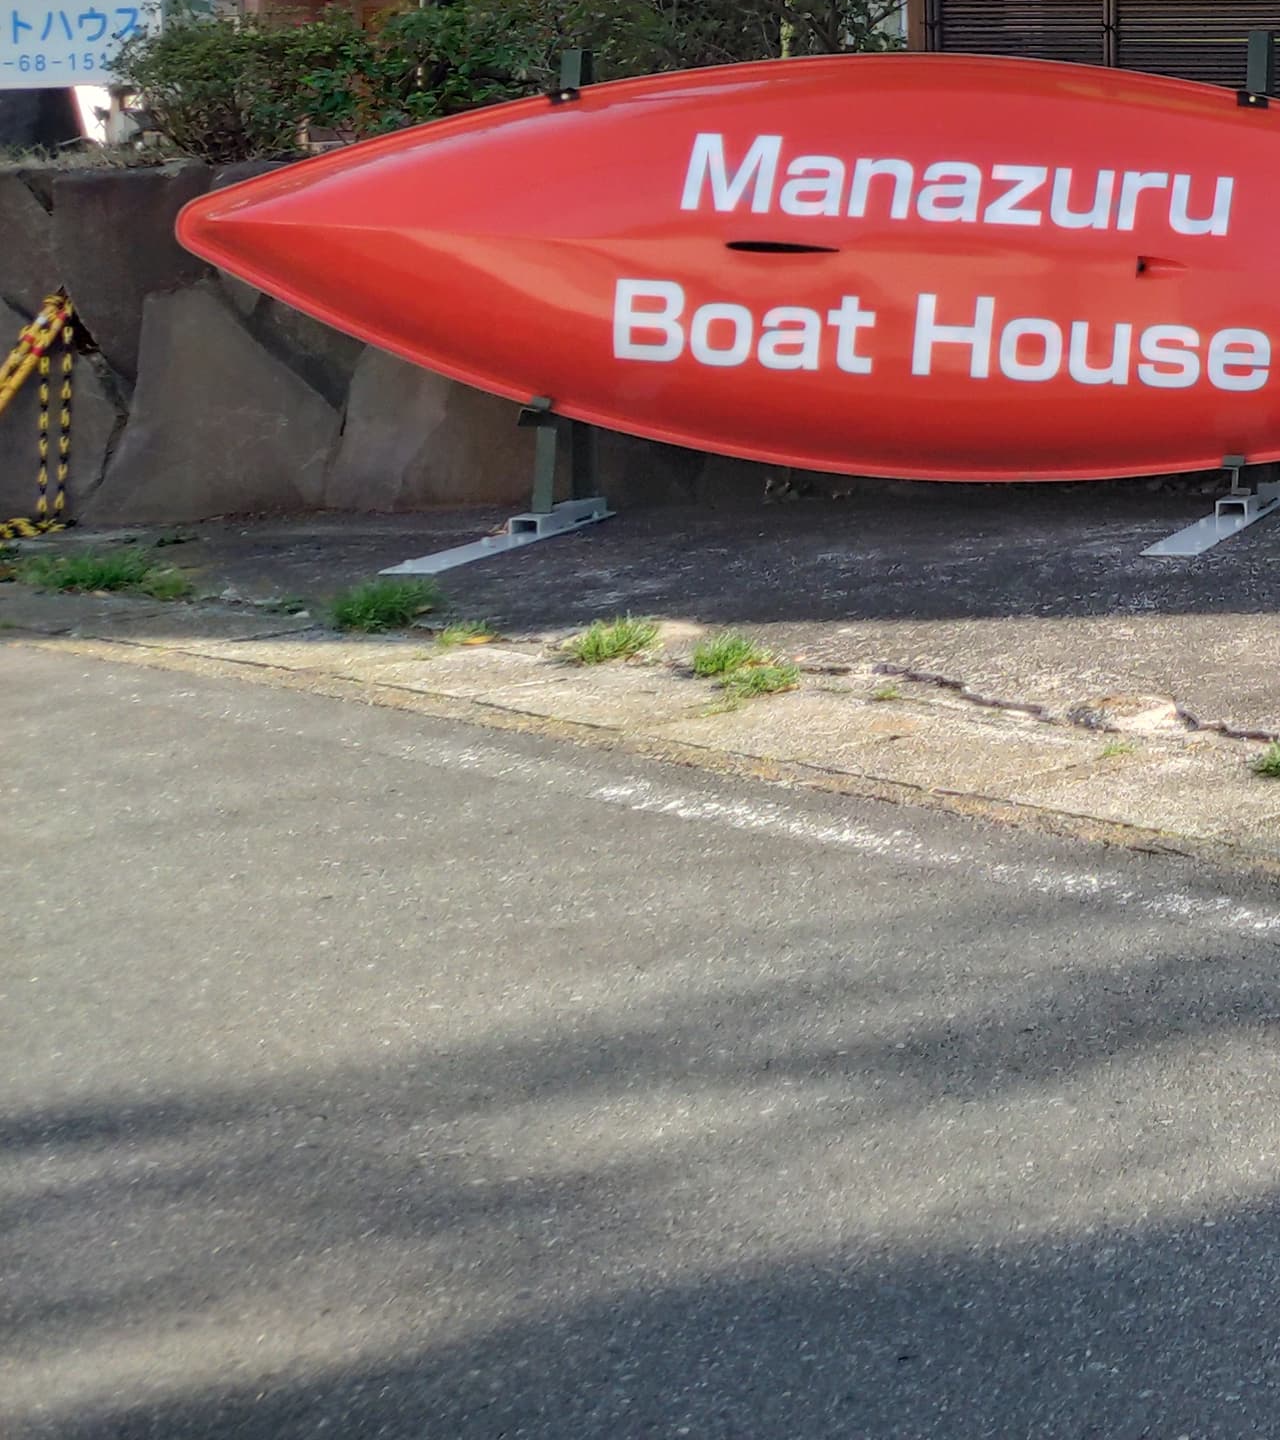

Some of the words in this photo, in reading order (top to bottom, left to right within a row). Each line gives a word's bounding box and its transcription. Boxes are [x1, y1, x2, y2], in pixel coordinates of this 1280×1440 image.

[680, 132, 1234, 237] Manazuru
[613, 278, 876, 374] Boat
[911, 292, 1272, 393] House
